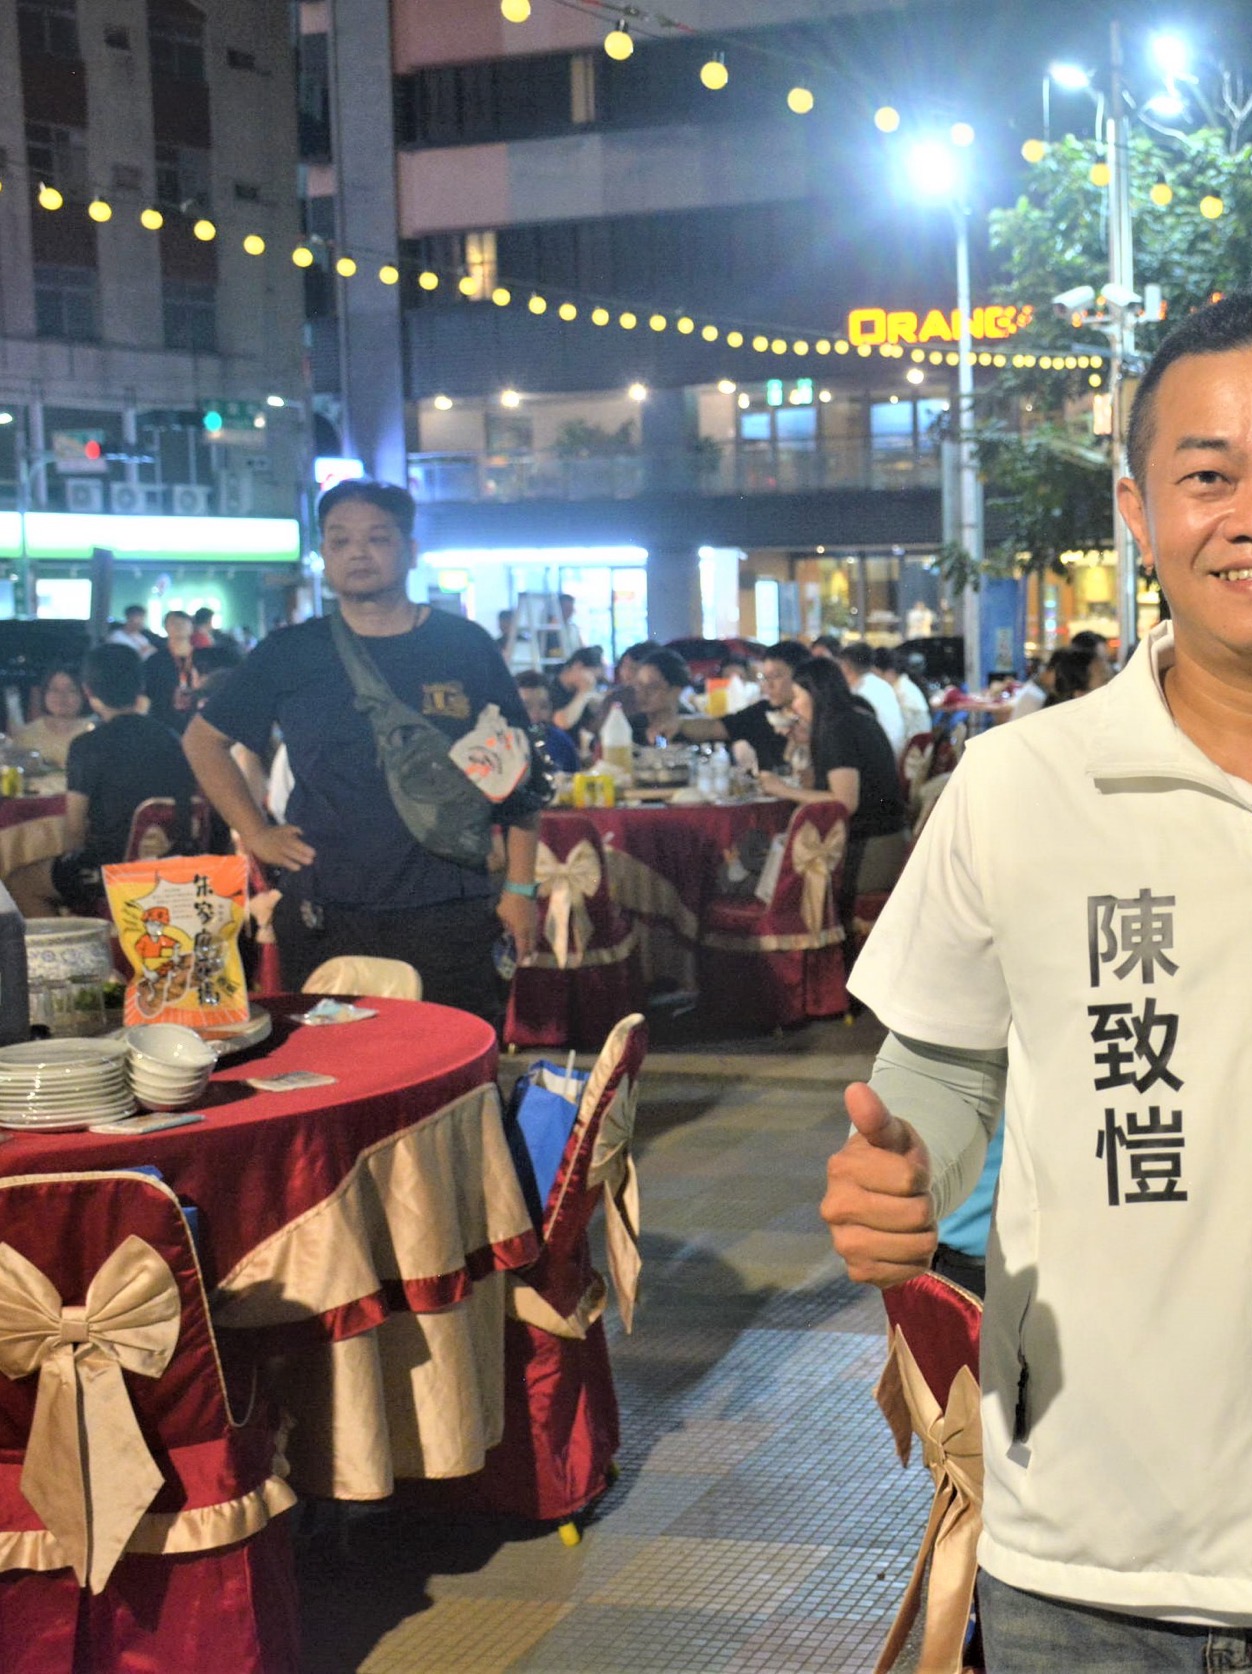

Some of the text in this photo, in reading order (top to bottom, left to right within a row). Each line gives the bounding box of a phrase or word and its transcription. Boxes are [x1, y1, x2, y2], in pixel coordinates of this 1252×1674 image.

[848, 306, 1033, 346] ORANG
[1087, 887, 1189, 1206] 陳致愷
